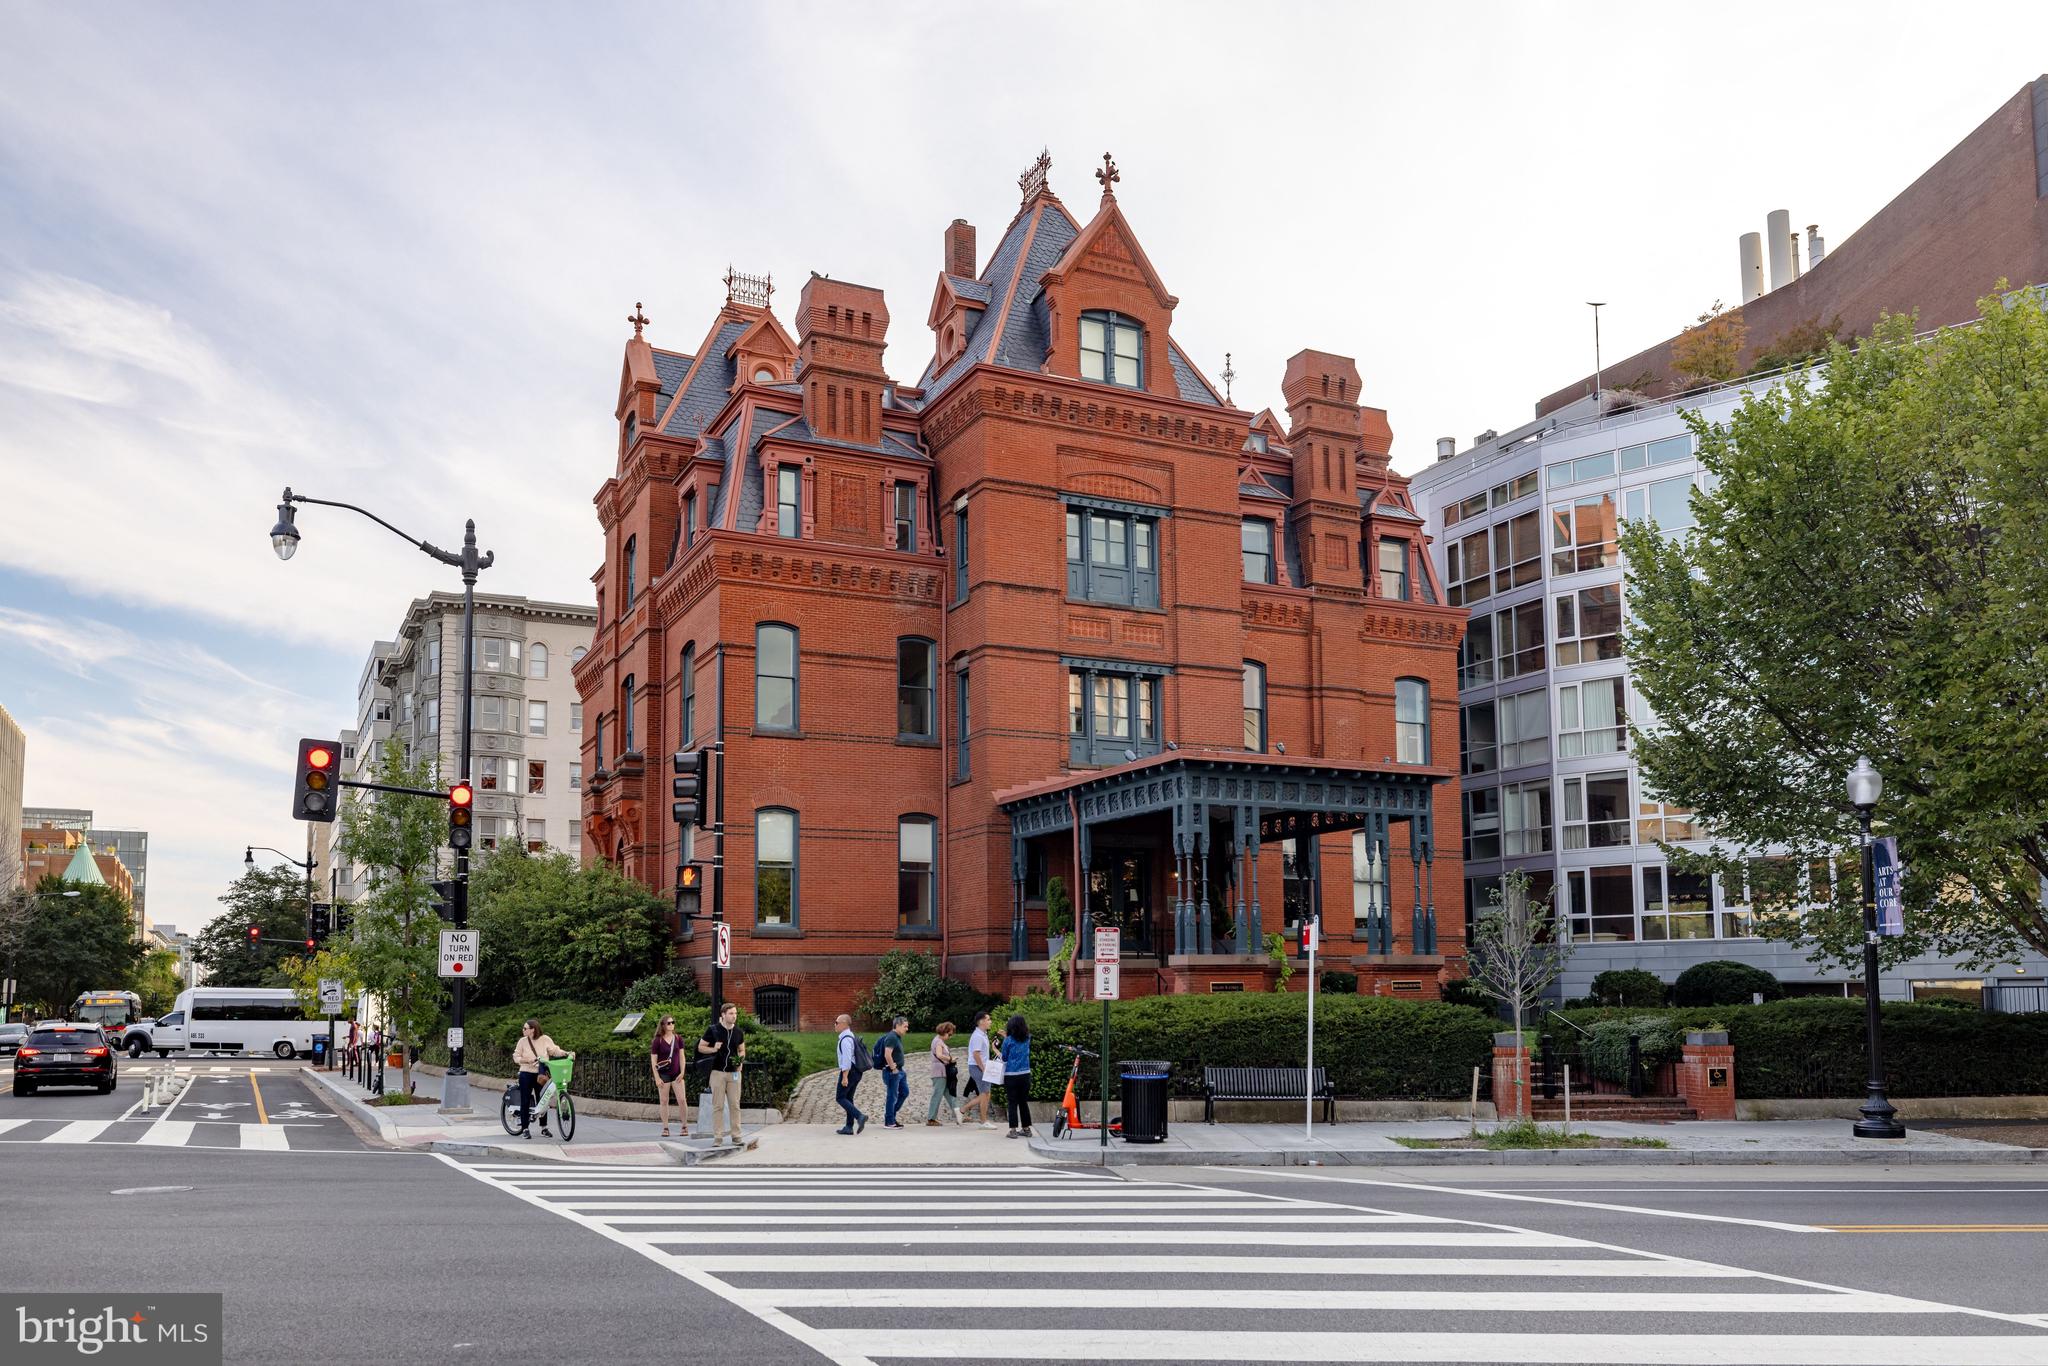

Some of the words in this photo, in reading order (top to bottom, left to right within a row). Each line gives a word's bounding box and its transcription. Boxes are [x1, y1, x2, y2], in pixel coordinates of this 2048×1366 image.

[1878, 867, 1894, 876] ARTS
[1878, 877, 1887, 887] AT
[1879, 887, 1894, 898] OUR
[1880, 897, 1898, 908] CORE
[451, 934, 468, 943] NO
[448, 944, 470, 953] TURN
[443, 953, 455, 961] ON
